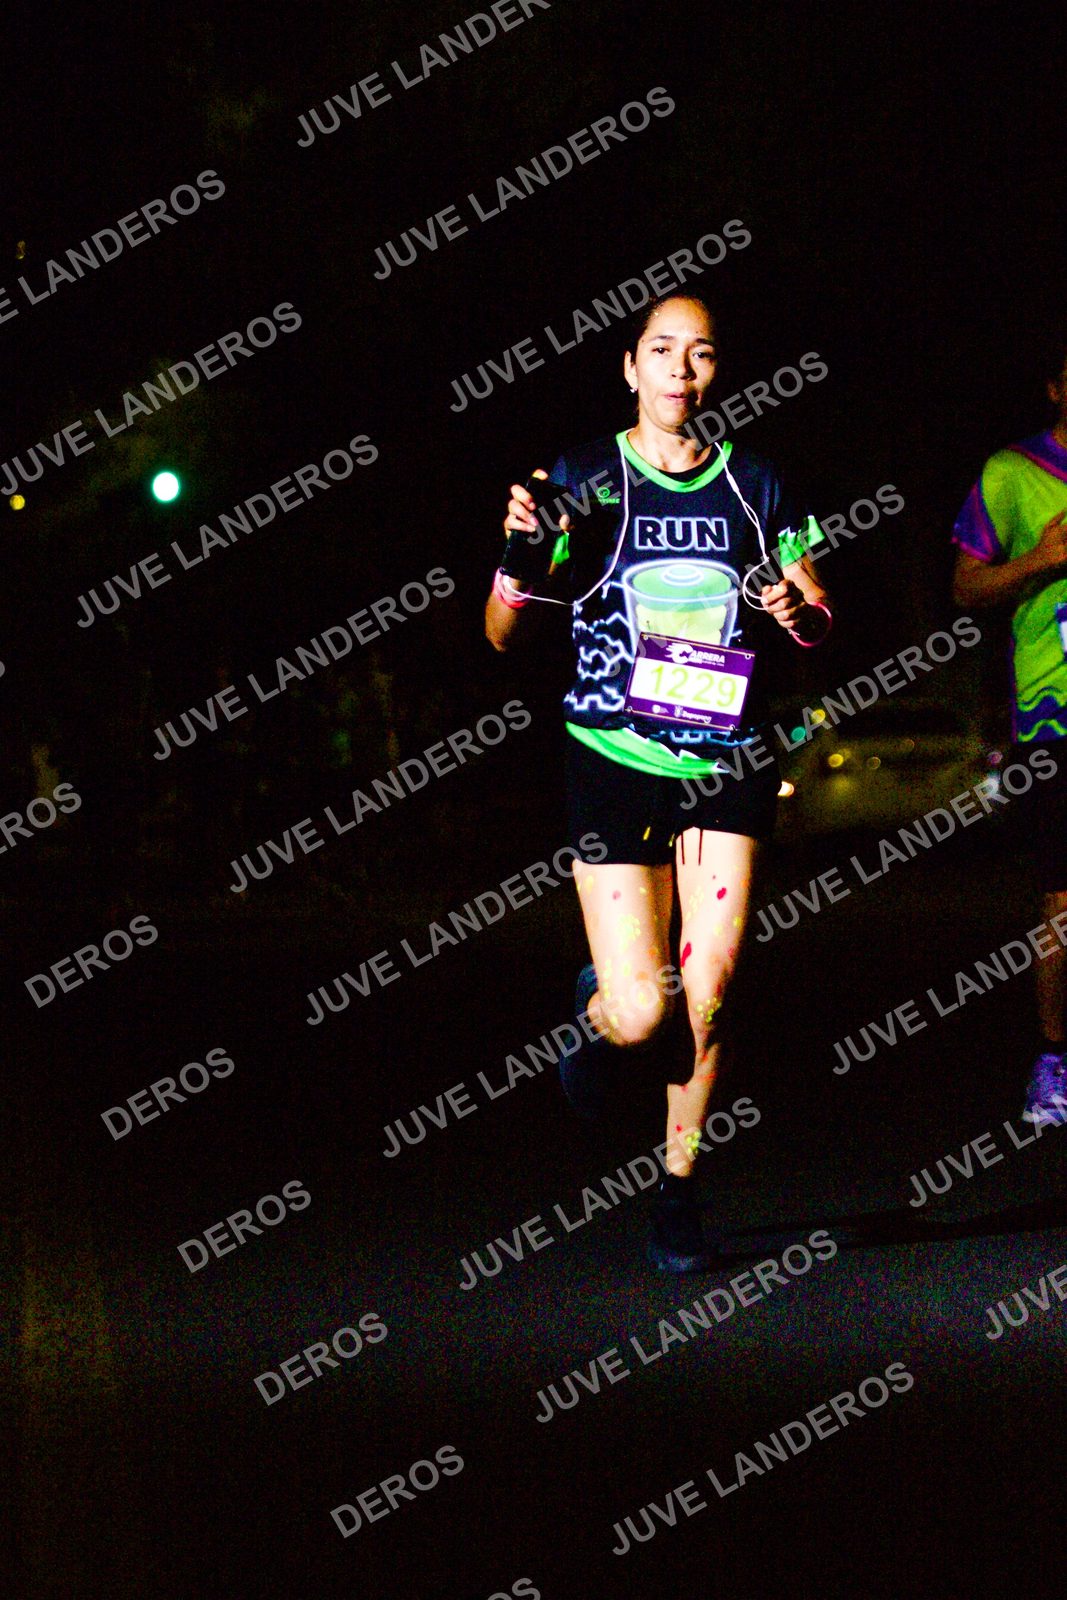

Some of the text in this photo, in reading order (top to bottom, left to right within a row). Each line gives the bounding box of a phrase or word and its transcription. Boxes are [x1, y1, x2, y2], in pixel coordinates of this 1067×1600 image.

[634, 516, 728, 551] RUN
[667, 643, 725, 664] CARRERA
[651, 664, 737, 708] 1229
